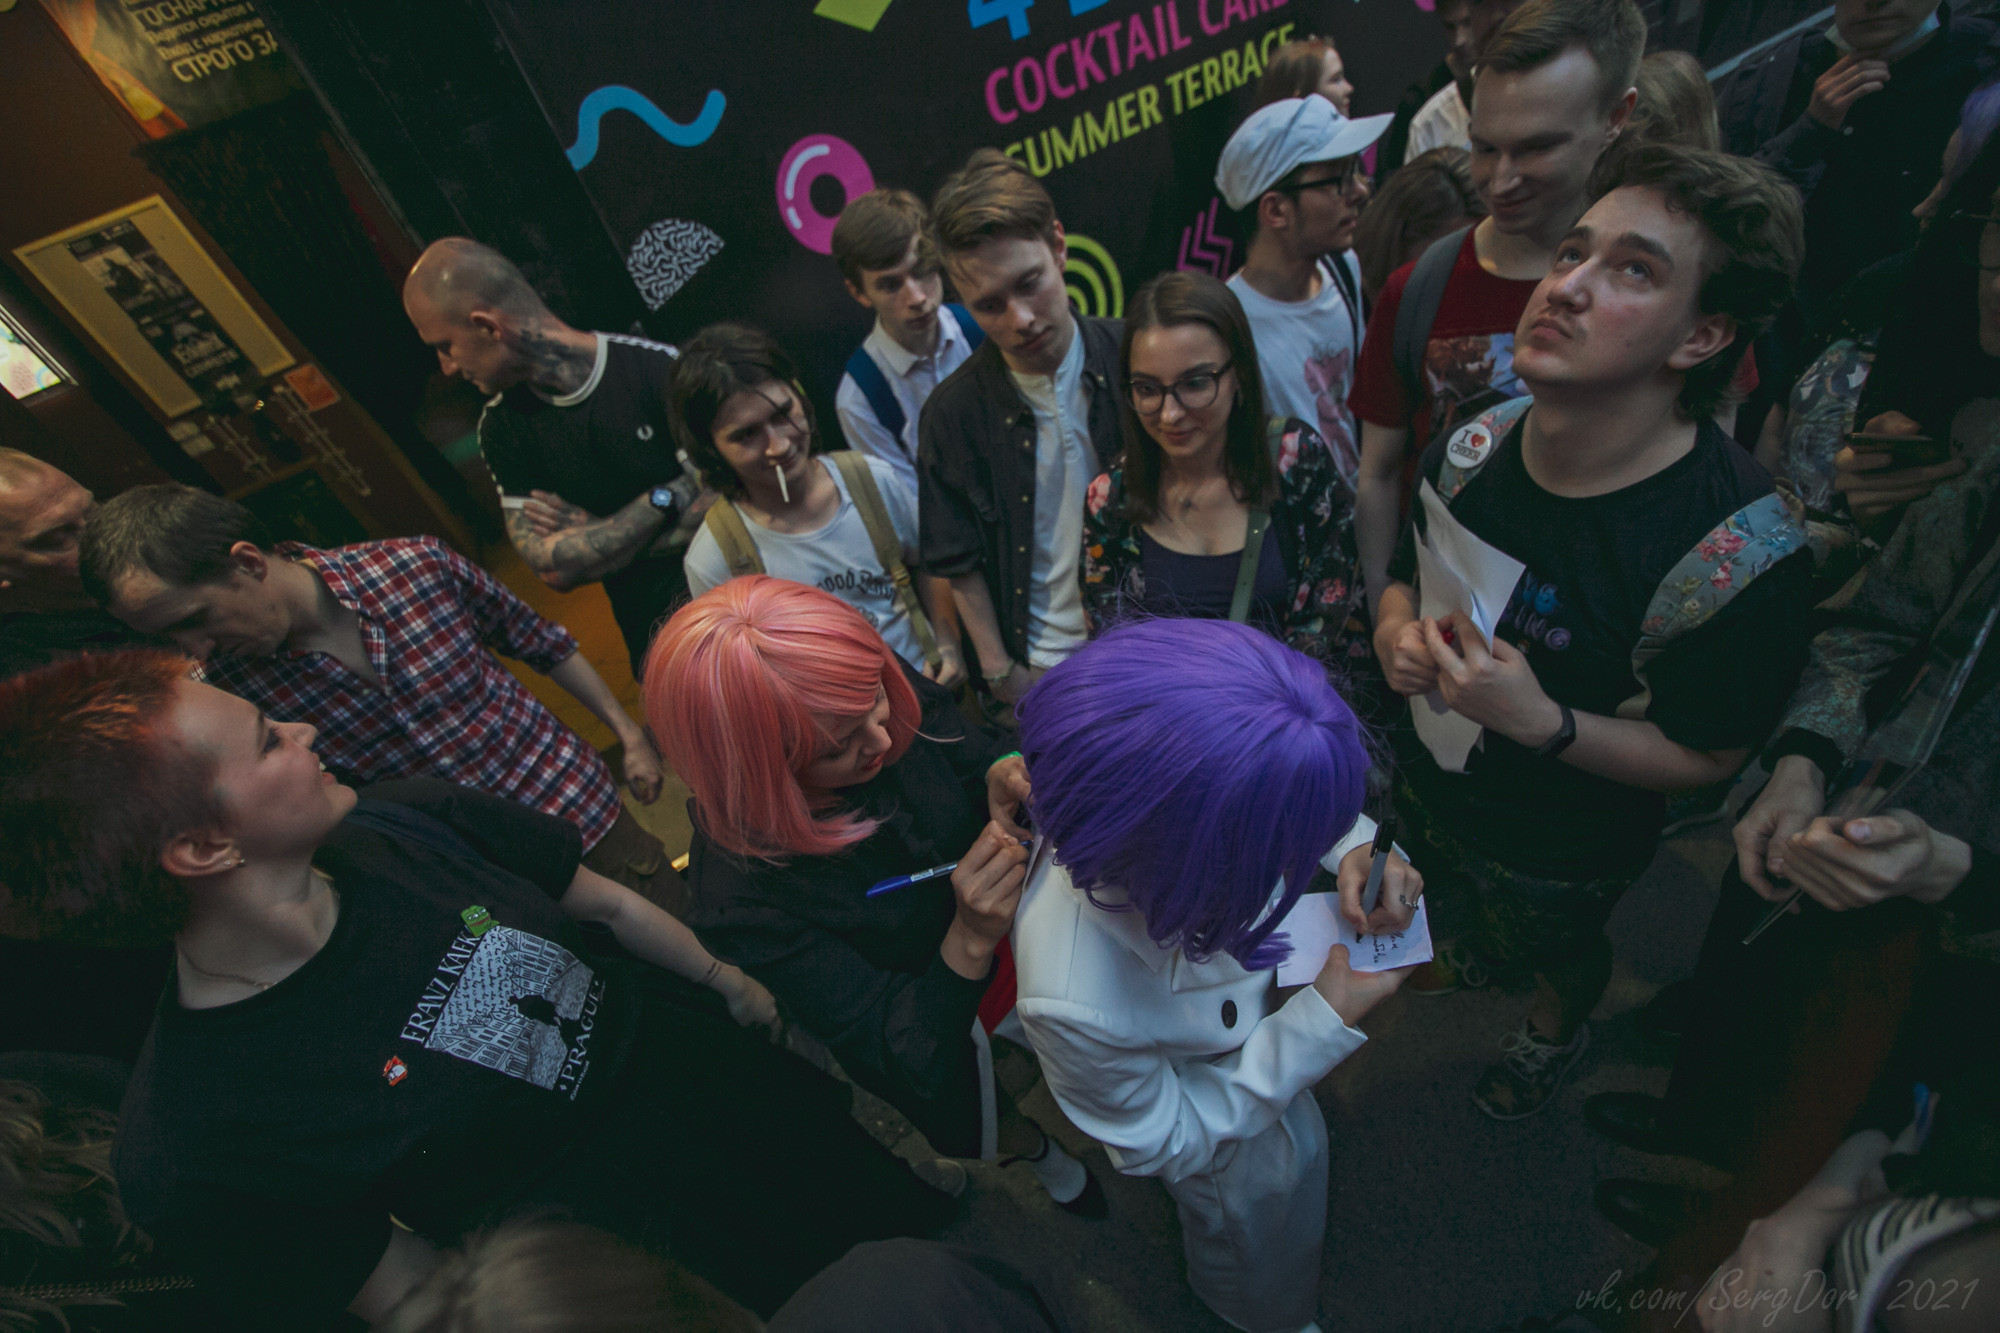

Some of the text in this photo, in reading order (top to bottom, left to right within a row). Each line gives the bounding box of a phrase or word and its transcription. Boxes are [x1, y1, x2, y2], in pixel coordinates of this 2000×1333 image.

[171, 39, 254, 83] СТРОГО
[985, 0, 1289, 124] COCKTAIL CA
[1004, 83, 1163, 178] SUMMER
[1459, 429, 1472, 444] I
[400, 924, 482, 1045] FRANZ KAFK
[559, 990, 603, 1084] PRAGUE
